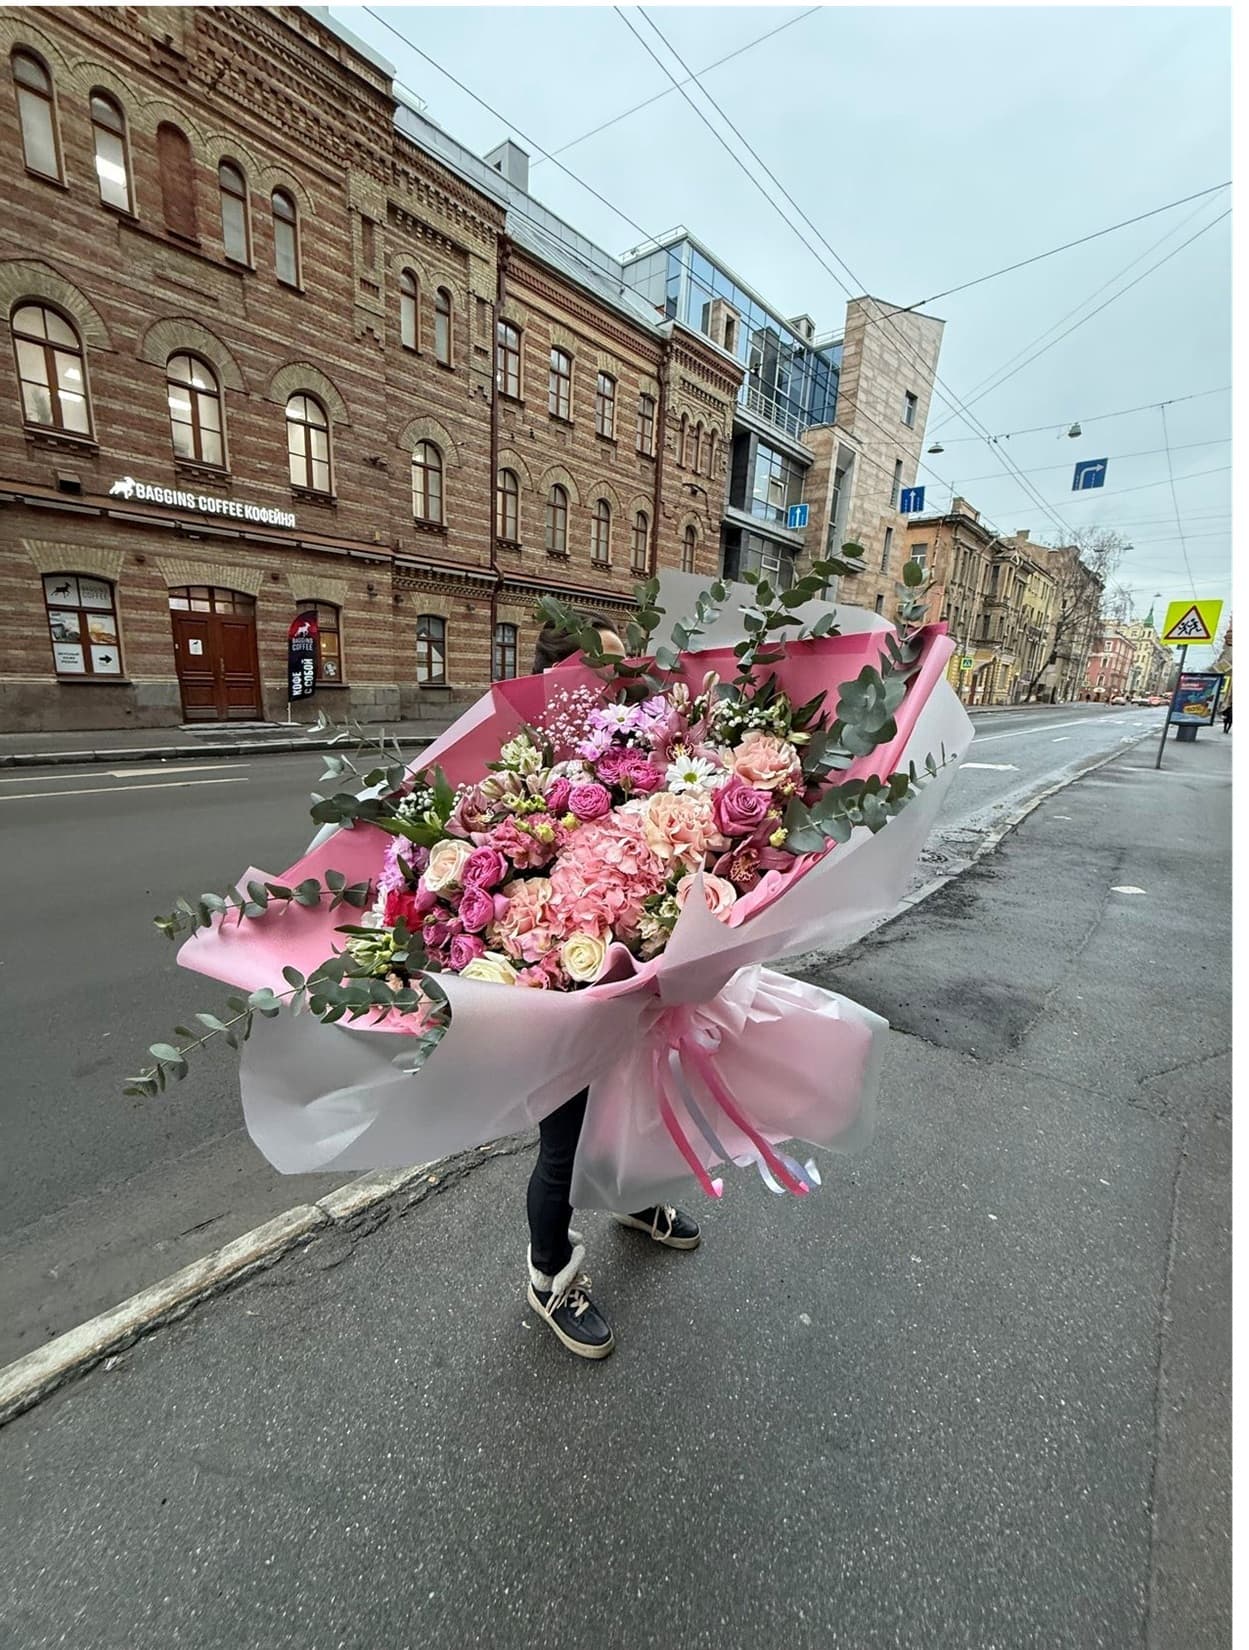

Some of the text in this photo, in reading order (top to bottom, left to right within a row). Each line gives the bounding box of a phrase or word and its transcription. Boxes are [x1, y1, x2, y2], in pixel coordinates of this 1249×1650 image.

[136, 482, 296, 528] BAGGINS COFFEE КОФЕЙНЯ
[292, 643, 313, 651] COFFEE
[292, 671, 302, 696] КОФЕ
[301, 658, 314, 687] СОБОЙ
